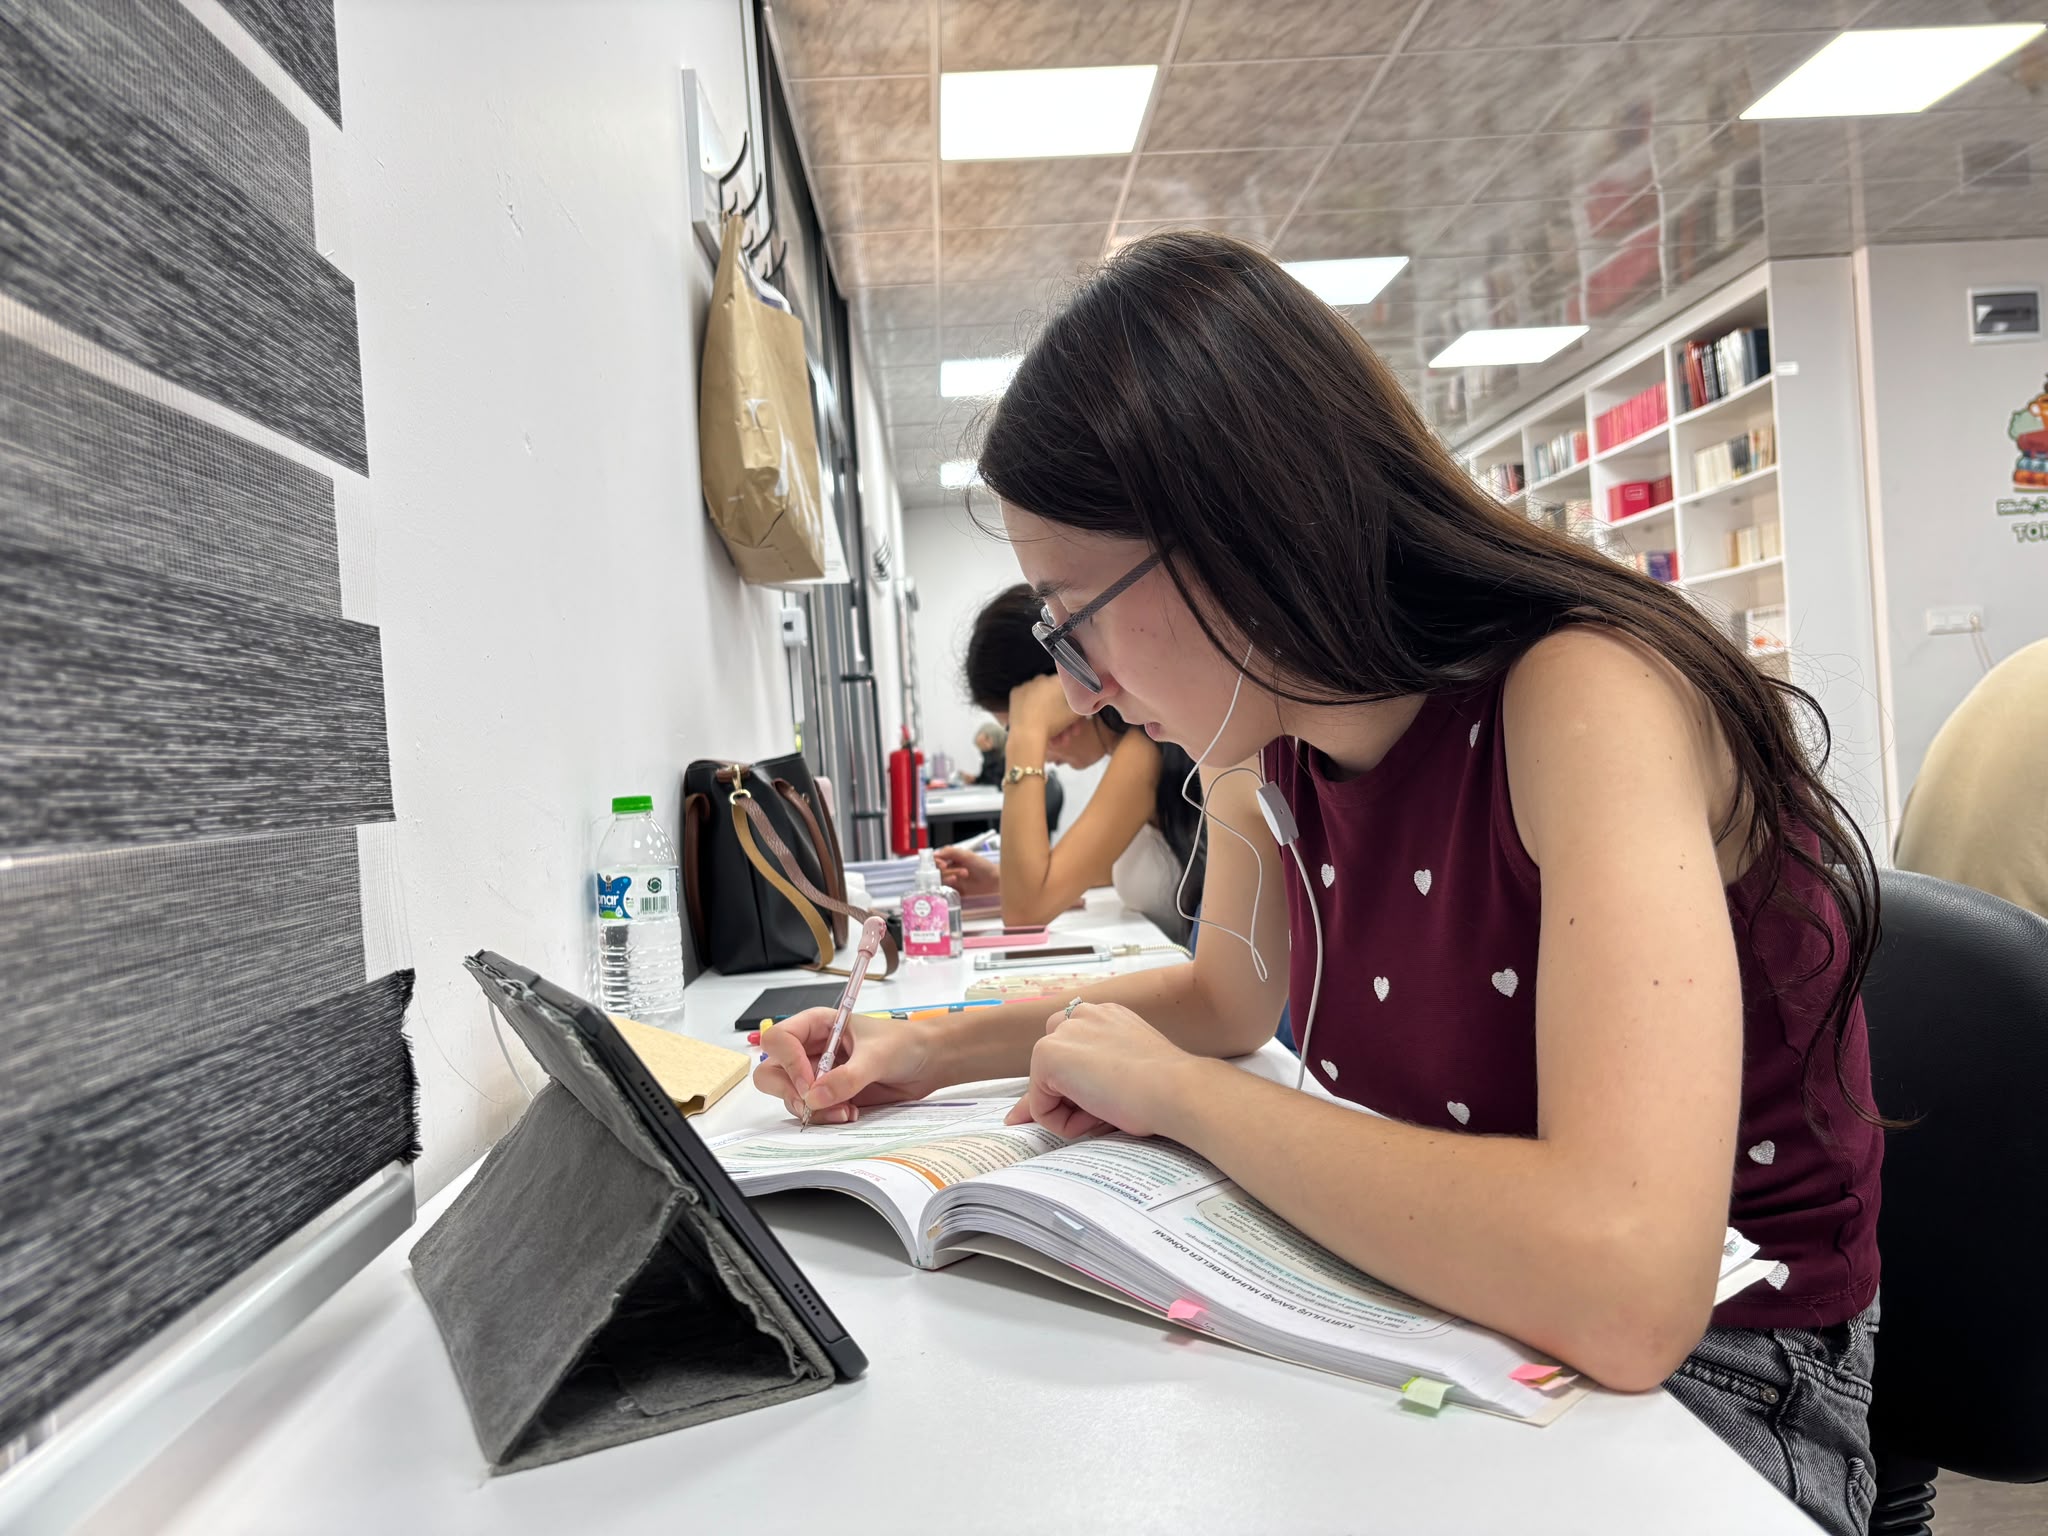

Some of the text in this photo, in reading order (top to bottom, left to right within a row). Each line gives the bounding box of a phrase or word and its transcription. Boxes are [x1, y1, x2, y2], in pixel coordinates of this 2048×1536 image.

[1102, 1182, 1143, 1204] MOSKOVA
[1112, 1179, 1140, 1193] MART
[1150, 1228, 1190, 1253] DÖNEMİ
[1187, 1251, 1261, 1294] MUHAREBELER
[1258, 1291, 1297, 1311] SAVAŞI
[1295, 1307, 1355, 1329] KURTULUŞ
